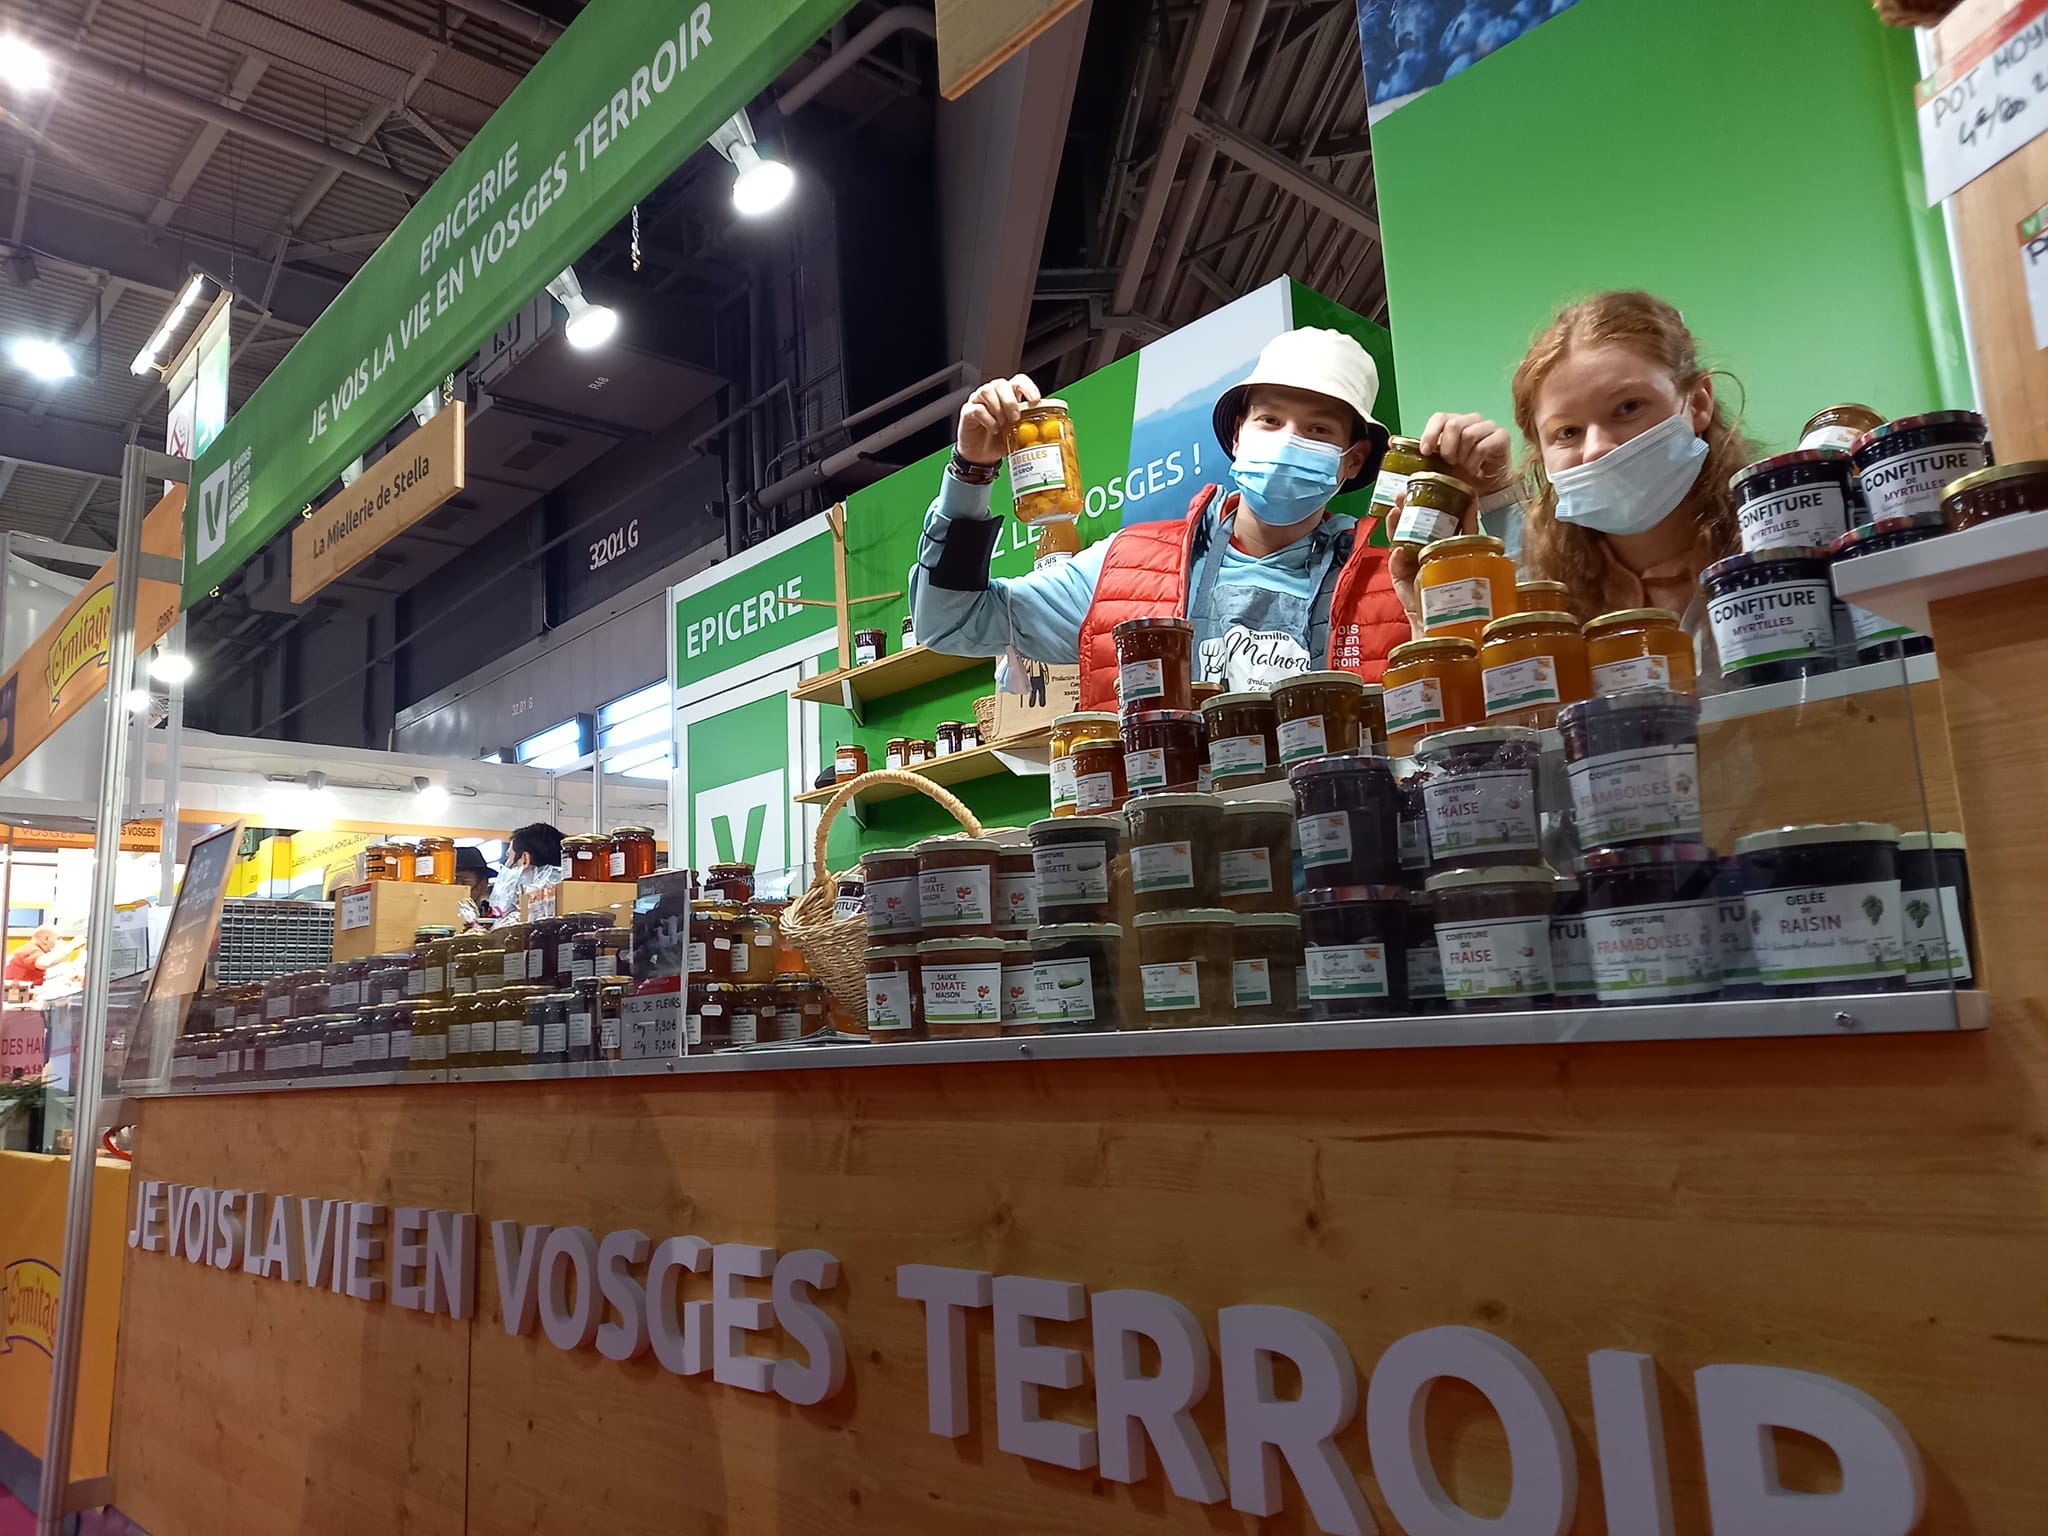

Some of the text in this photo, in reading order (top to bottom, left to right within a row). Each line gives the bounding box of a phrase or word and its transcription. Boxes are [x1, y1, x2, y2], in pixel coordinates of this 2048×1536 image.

[1933, 67, 1979, 128] POT
[419, 141, 519, 275] EPICERIE
[308, 2, 713, 444] JE VOIS LA VIE EN VOSGES TERROIR
[1012, 450, 1048, 464] ABELLES
[1865, 453, 1968, 492] CONFITURE
[1084, 450, 1184, 518] OSGES
[1884, 479, 1946, 502] MYRTILLES
[313, 455, 429, 559] La Miellerie de Stella
[1738, 492, 1823, 528] ONFITURE
[1752, 519, 1800, 542] MYRTILLES
[1714, 590, 1816, 624] CONFITURE
[686, 575, 804, 660] EPICERIE
[1732, 616, 1794, 636] MYRTILLES
[1249, 630, 1290, 641] Famille
[1337, 624, 1359, 634] OIS
[1333, 657, 1360, 668] ROIR
[1437, 802, 1479, 819] FRAISE
[128, 827, 156, 838] VOSGES
[1785, 891, 1827, 906] GELÉE
[1611, 915, 1665, 927] CONFITURE
[1780, 915, 1842, 935] RAISIN
[1445, 930, 1489, 941] CONFITURE
[1596, 934, 1692, 954] FRAMBOISES
[1450, 949, 1492, 965] FRAISE
[930, 981, 967, 991] TOMATE
[937, 973, 957, 981] SAUCE
[935, 991, 960, 999] MAISON
[128, 1181, 168, 1252] JE
[167, 1184, 243, 1272] VOIS
[243, 1191, 302, 1282] LA
[301, 1197, 387, 1301] VIE
[392, 1207, 478, 1321] EN
[491, 1219, 848, 1406] VOSGES
